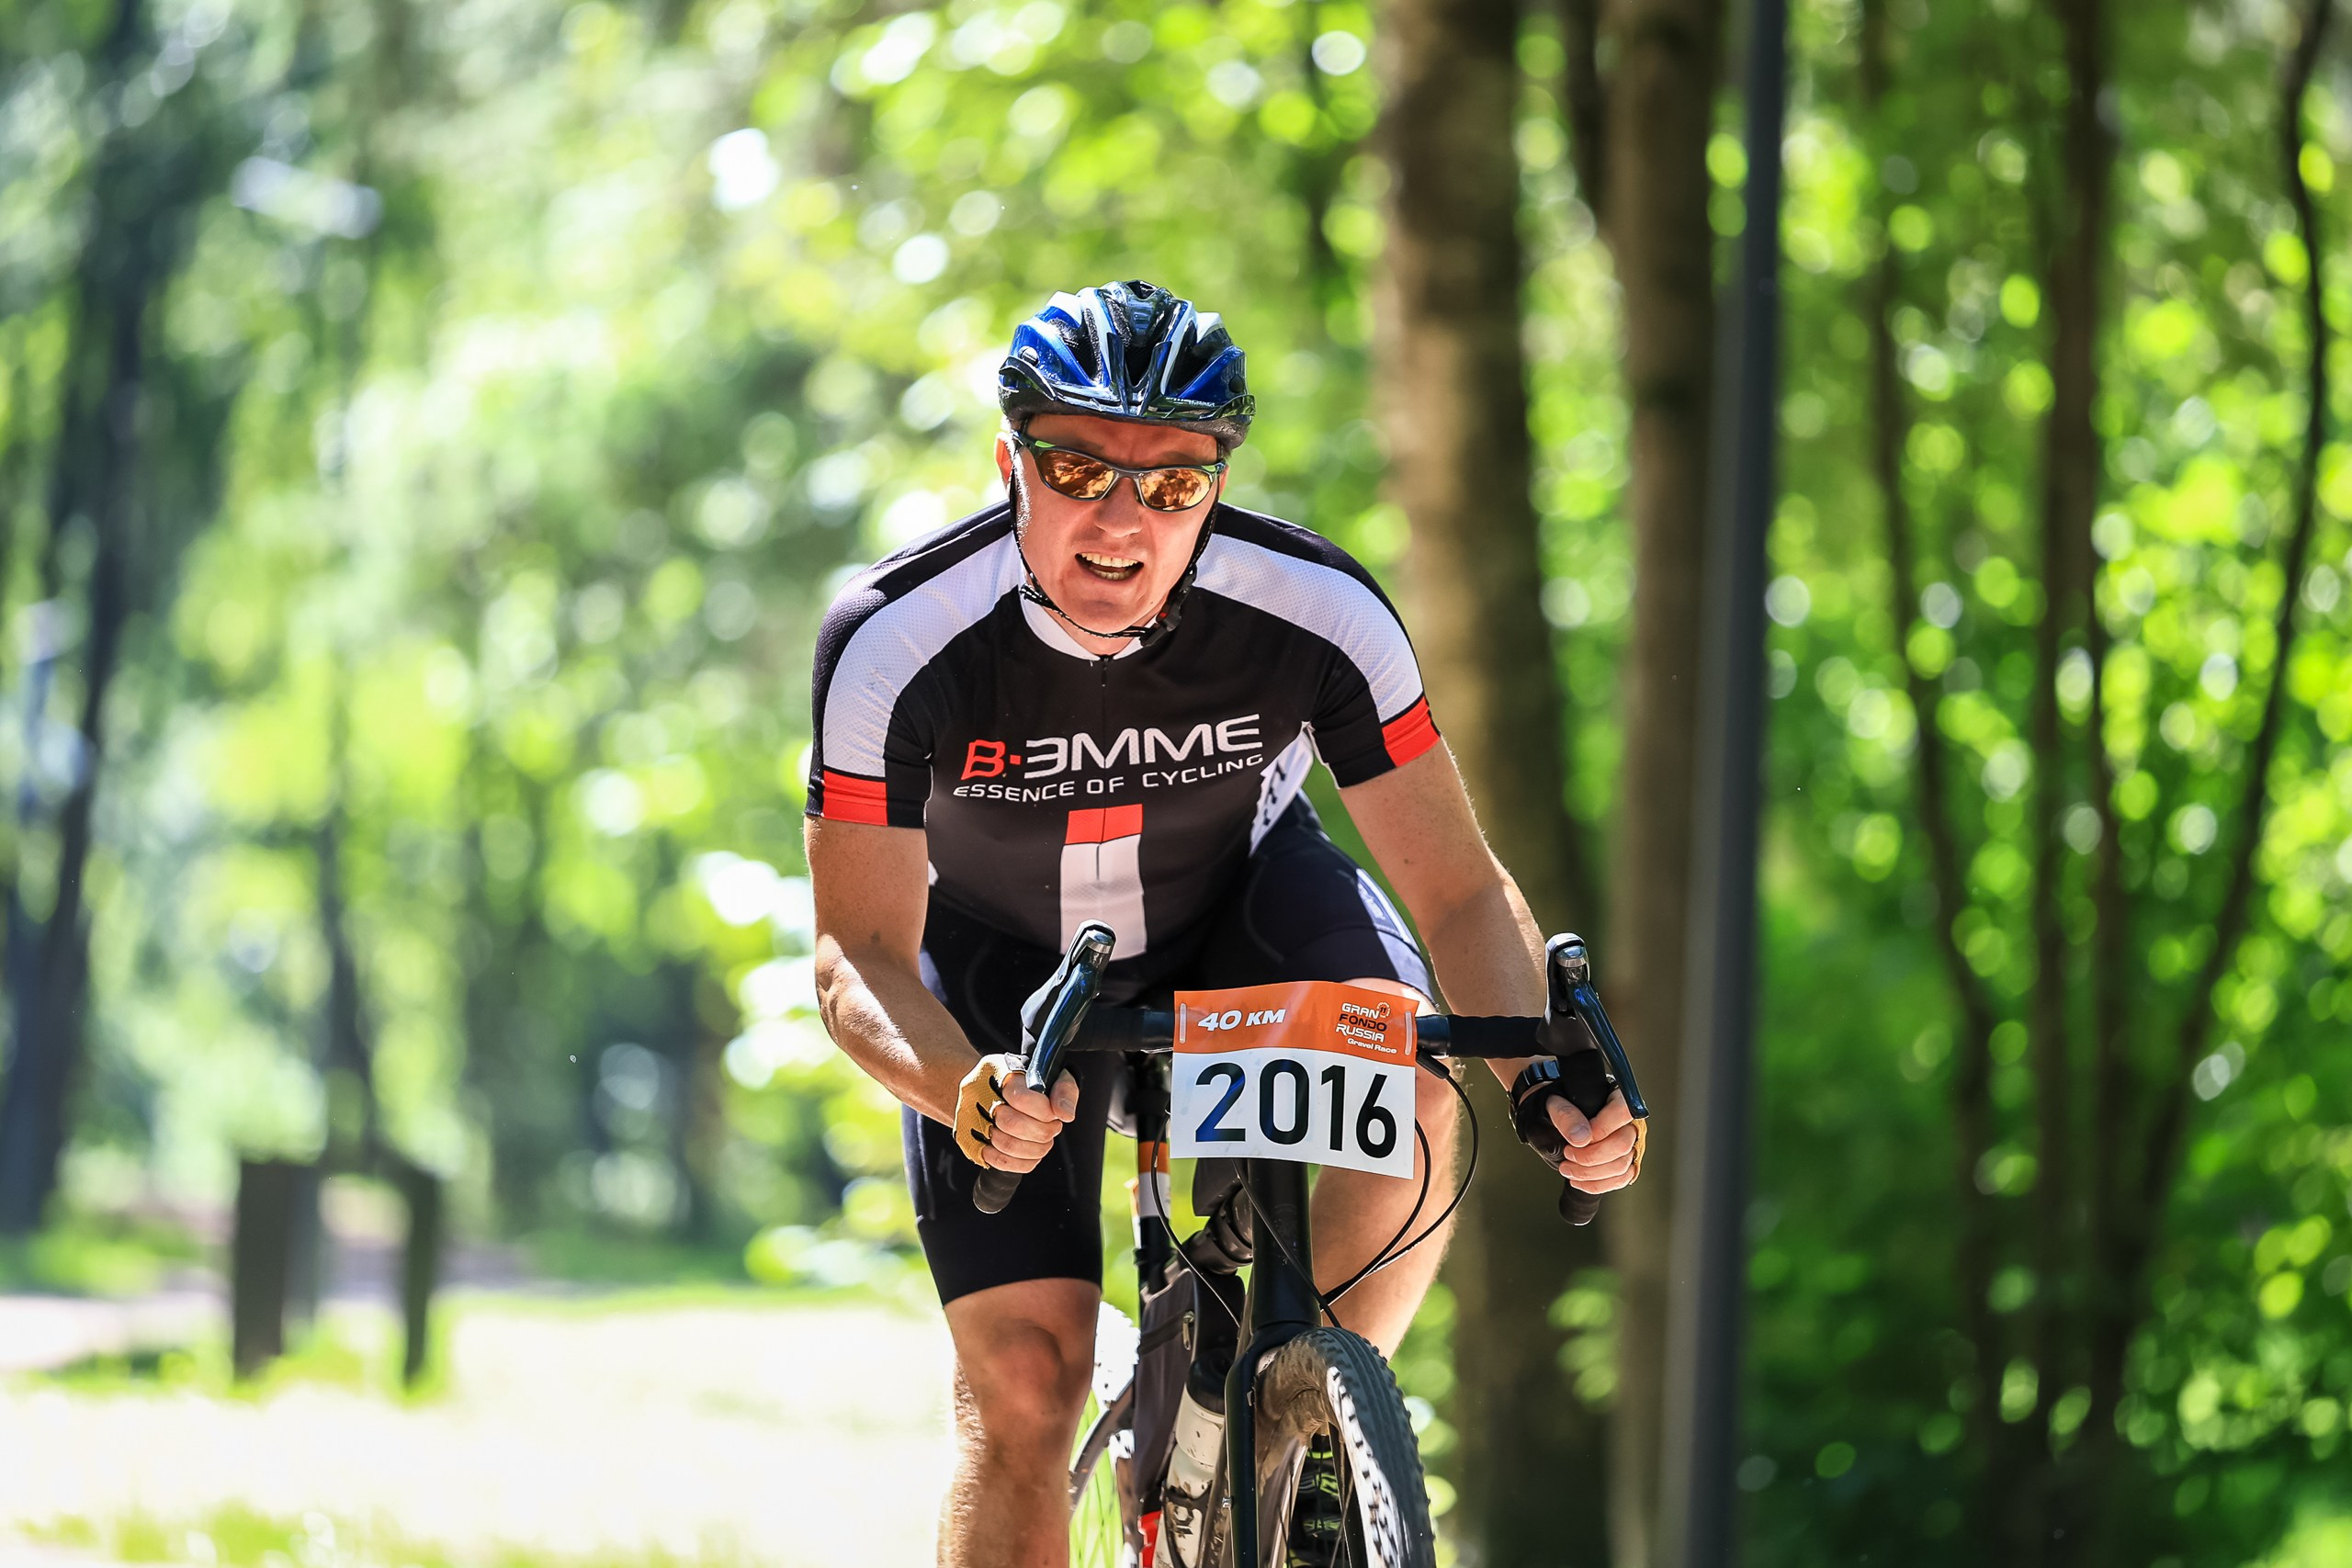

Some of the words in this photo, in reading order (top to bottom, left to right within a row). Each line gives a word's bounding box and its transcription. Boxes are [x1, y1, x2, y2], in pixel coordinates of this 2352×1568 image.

[953, 781, 1075, 803] ESSENCE
[1086, 776, 1125, 795] OF
[1142, 753, 1263, 788] CYCLING
[1197, 1010, 1242, 1032] 40
[1245, 1009, 1286, 1027] KM
[1341, 1002, 1379, 1020] GRAN
[1339, 1013, 1387, 1032] FONDO
[1336, 1023, 1385, 1043] RUSSIA
[1347, 1038, 1374, 1050] Gravel
[1374, 1045, 1396, 1054] Race
[1195, 1058, 1397, 1159] 2016
